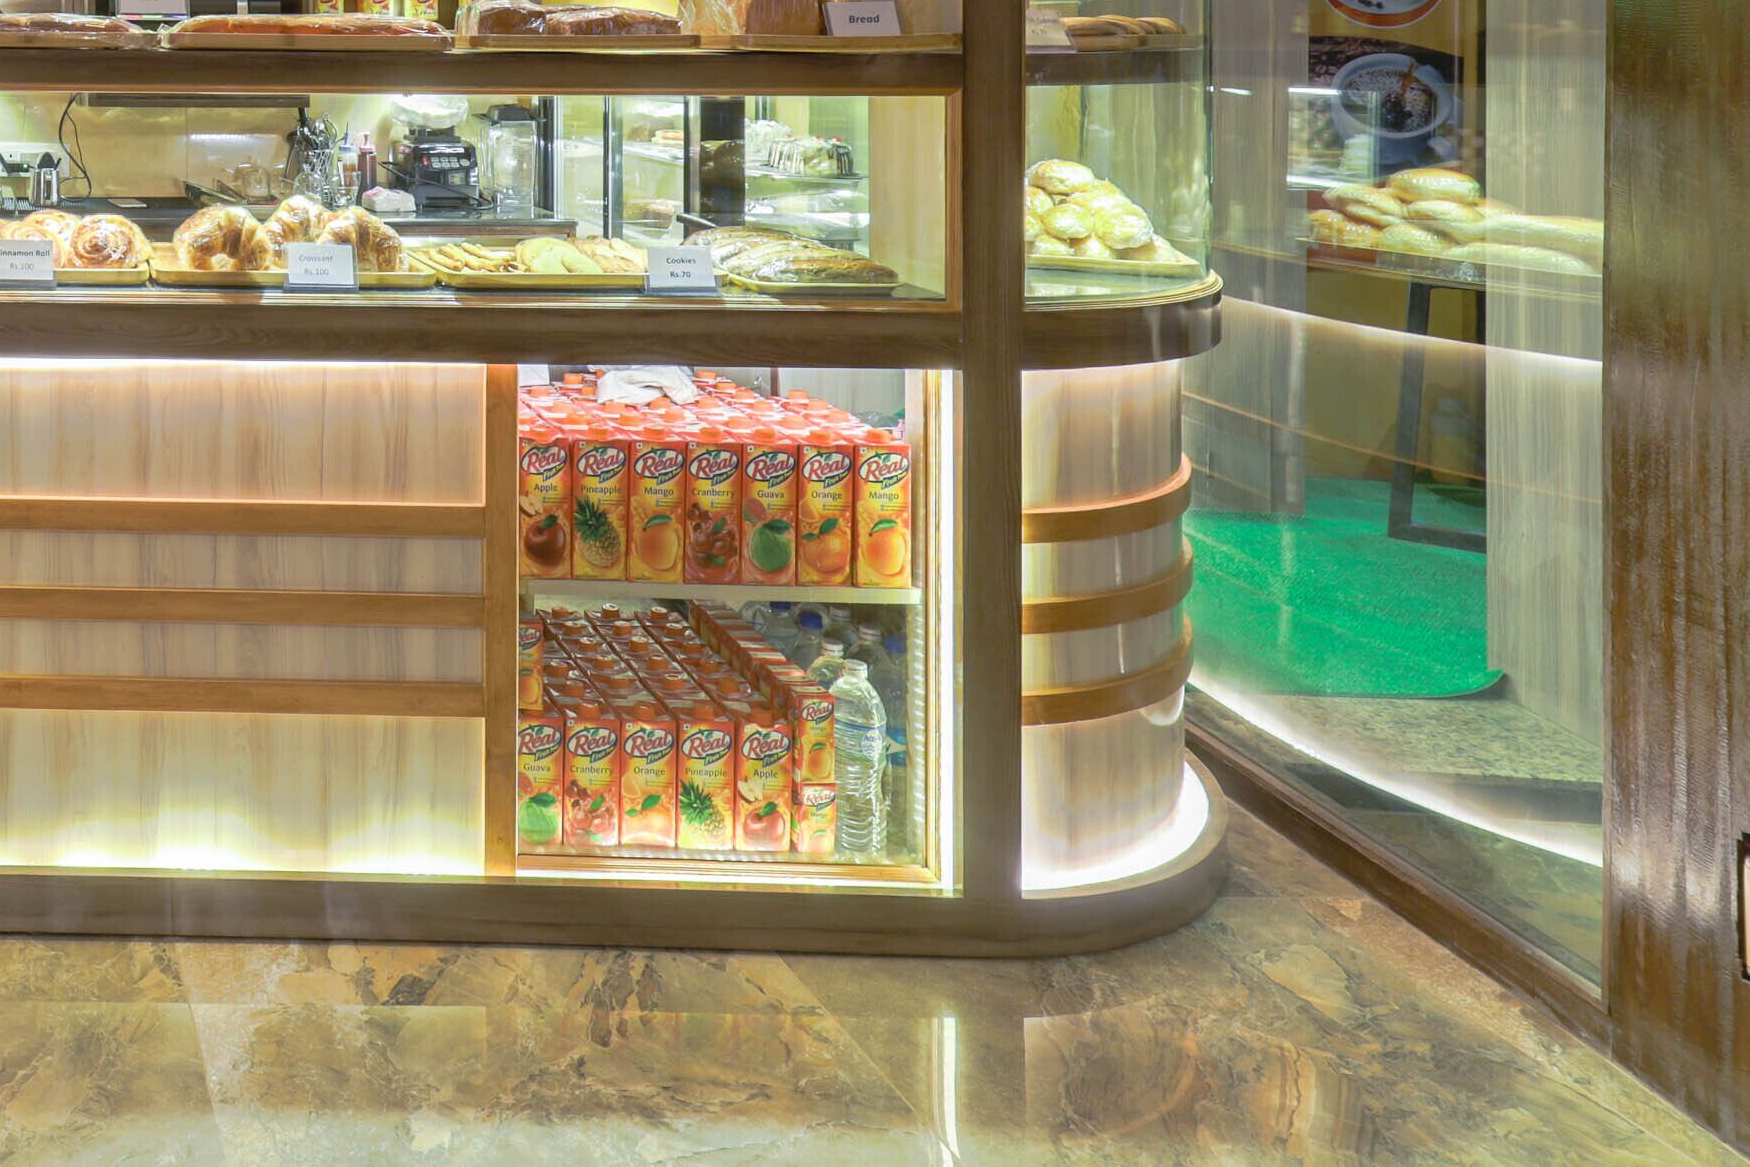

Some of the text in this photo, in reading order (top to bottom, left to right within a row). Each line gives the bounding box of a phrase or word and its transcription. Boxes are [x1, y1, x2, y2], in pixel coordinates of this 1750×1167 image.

[849, 15, 880, 23] Bread
[526, 449, 565, 474] Real
[583, 450, 621, 477] Real
[639, 453, 680, 479] Real
[695, 455, 734, 482] Real
[750, 456, 792, 482] Real
[806, 458, 847, 483] Real
[863, 459, 906, 485] Real
[534, 483, 558, 494] Apple
[580, 484, 621, 496] Pineapple
[644, 486, 674, 498] Mango
[692, 486, 734, 500] Cranberry
[757, 490, 785, 499] Guava
[811, 490, 843, 502] Orange
[868, 491, 899, 503] Mango
[803, 703, 831, 720] Real
[518, 732, 557, 755] Real
[572, 733, 613, 759] Real
[629, 736, 669, 762] Real
[687, 734, 729, 760] Real
[746, 734, 786, 759] Real
[523, 763, 550, 772] Guava
[569, 764, 613, 776] Cranberry
[633, 766, 666, 776] Orange
[685, 767, 727, 778] Pineapple
[753, 768, 779, 780] Apple
